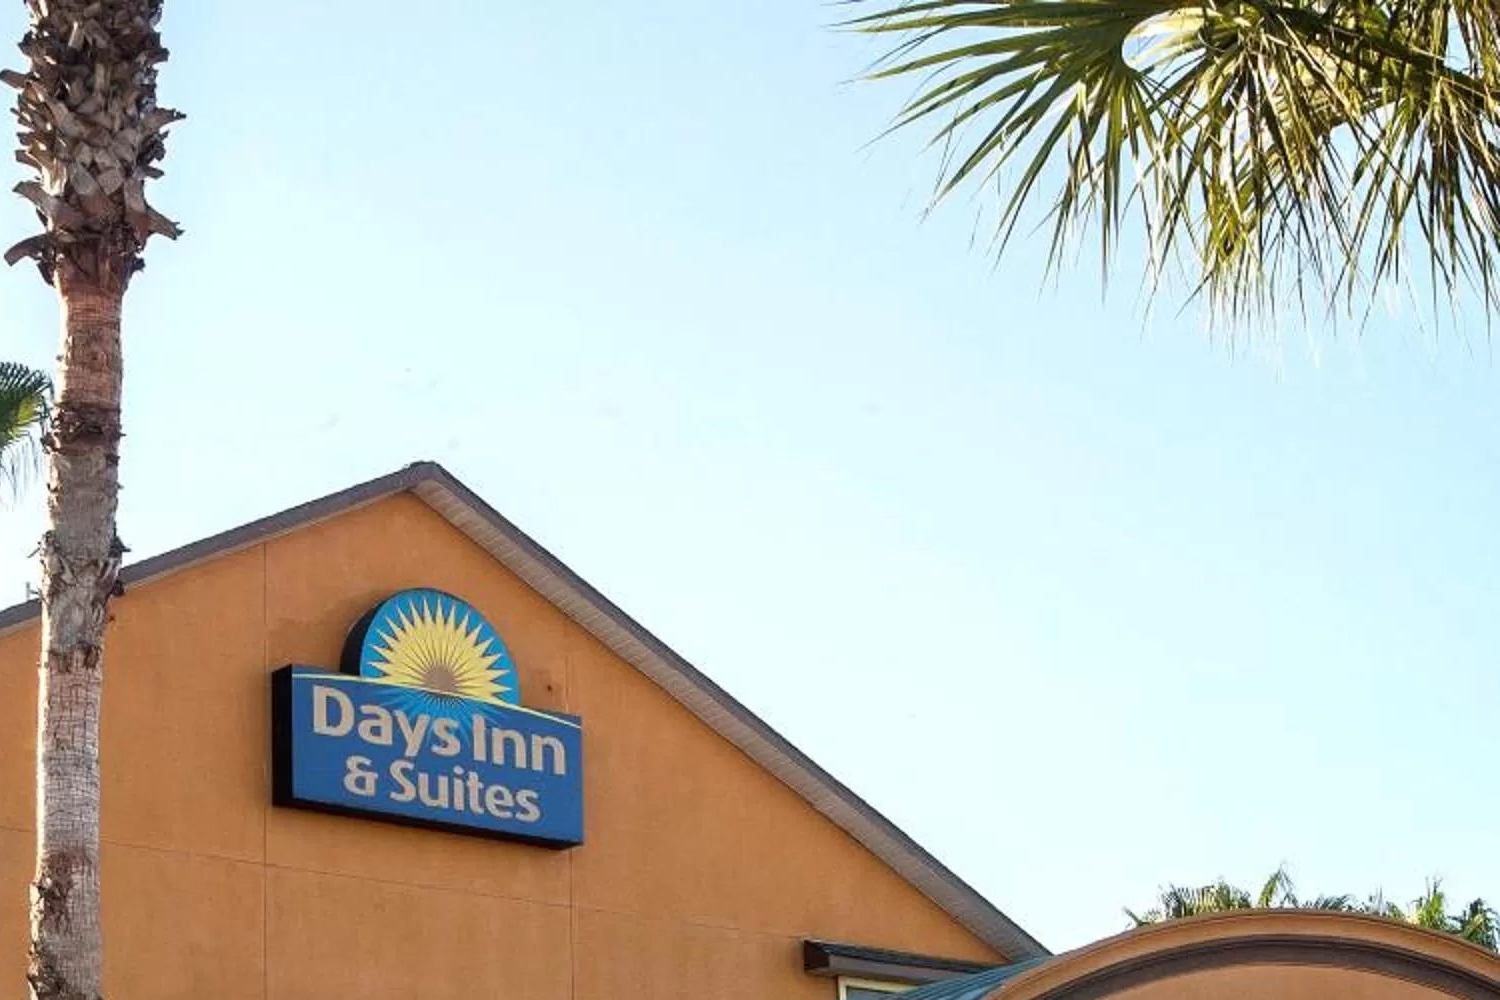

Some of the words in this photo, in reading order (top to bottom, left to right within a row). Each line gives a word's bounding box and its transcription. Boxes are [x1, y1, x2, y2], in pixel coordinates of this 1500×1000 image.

[312, 685, 462, 757] Days
[473, 714, 566, 775] Inn
[343, 755, 379, 797] &
[389, 759, 541, 823] Suites
